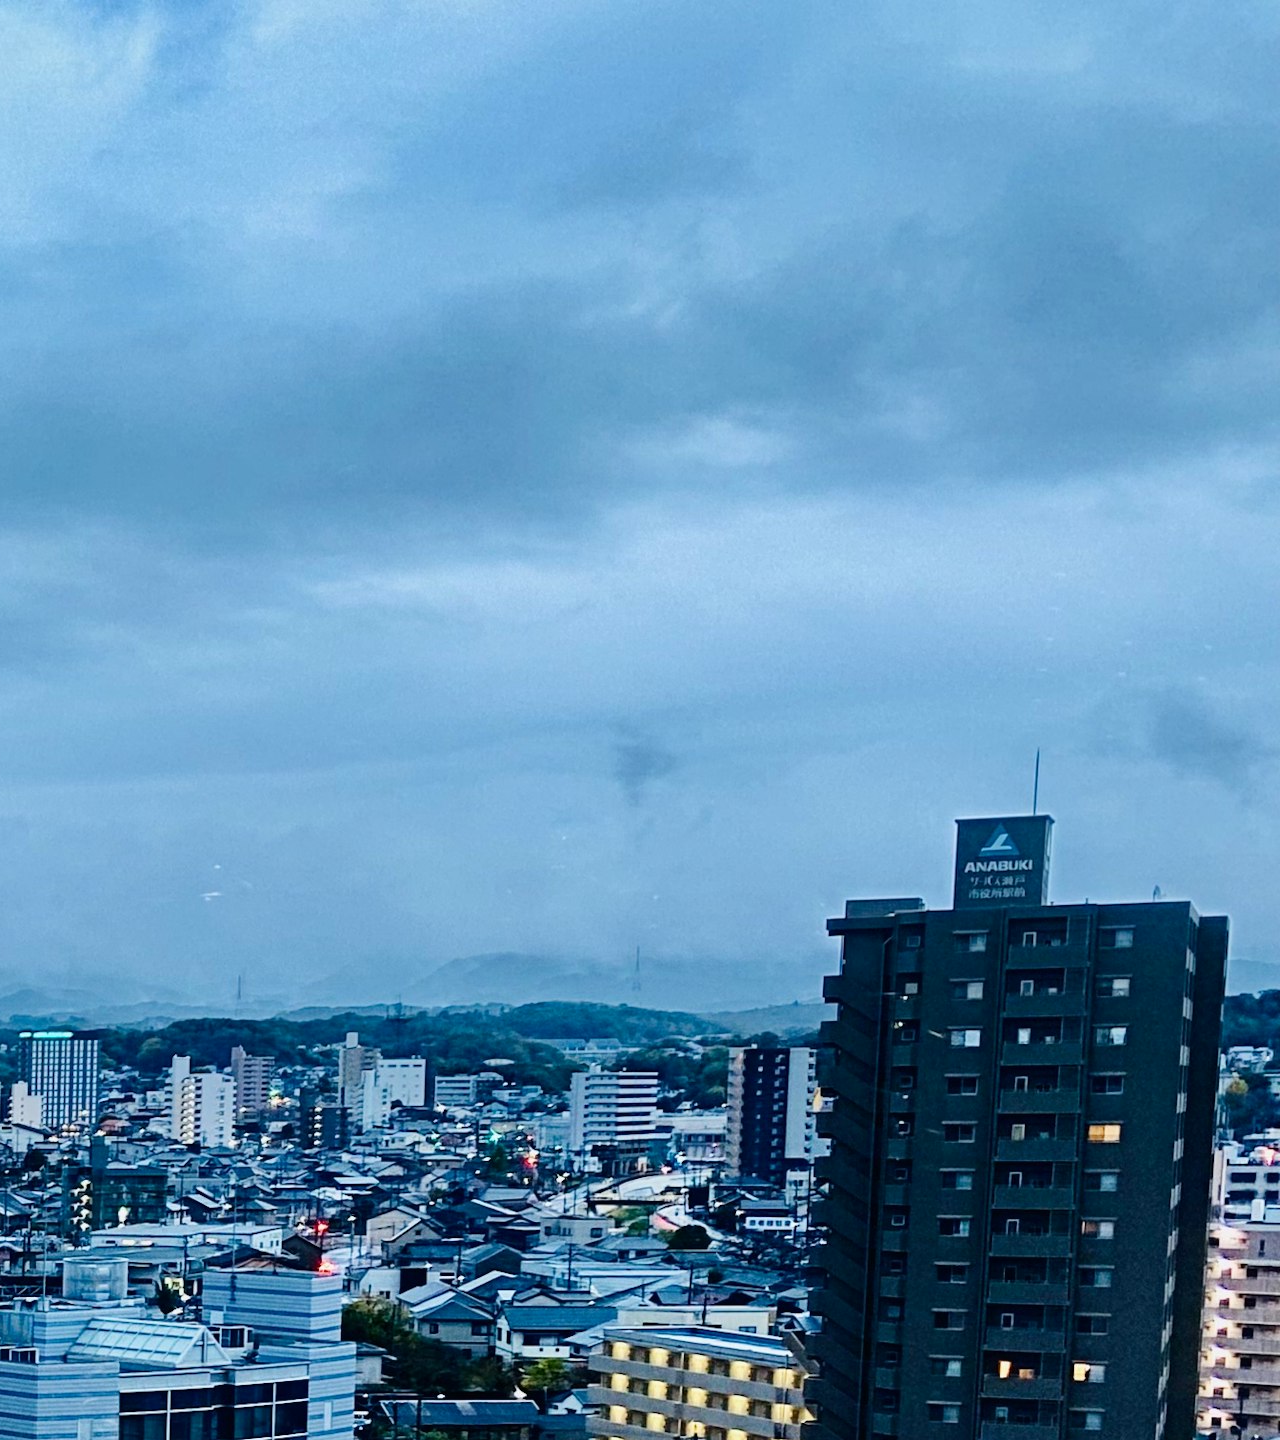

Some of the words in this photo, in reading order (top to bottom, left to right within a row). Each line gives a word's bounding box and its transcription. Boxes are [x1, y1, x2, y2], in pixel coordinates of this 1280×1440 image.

[964, 859, 1033, 873] ANABUKI
[968, 887, 1026, 899] 市役所駅前
